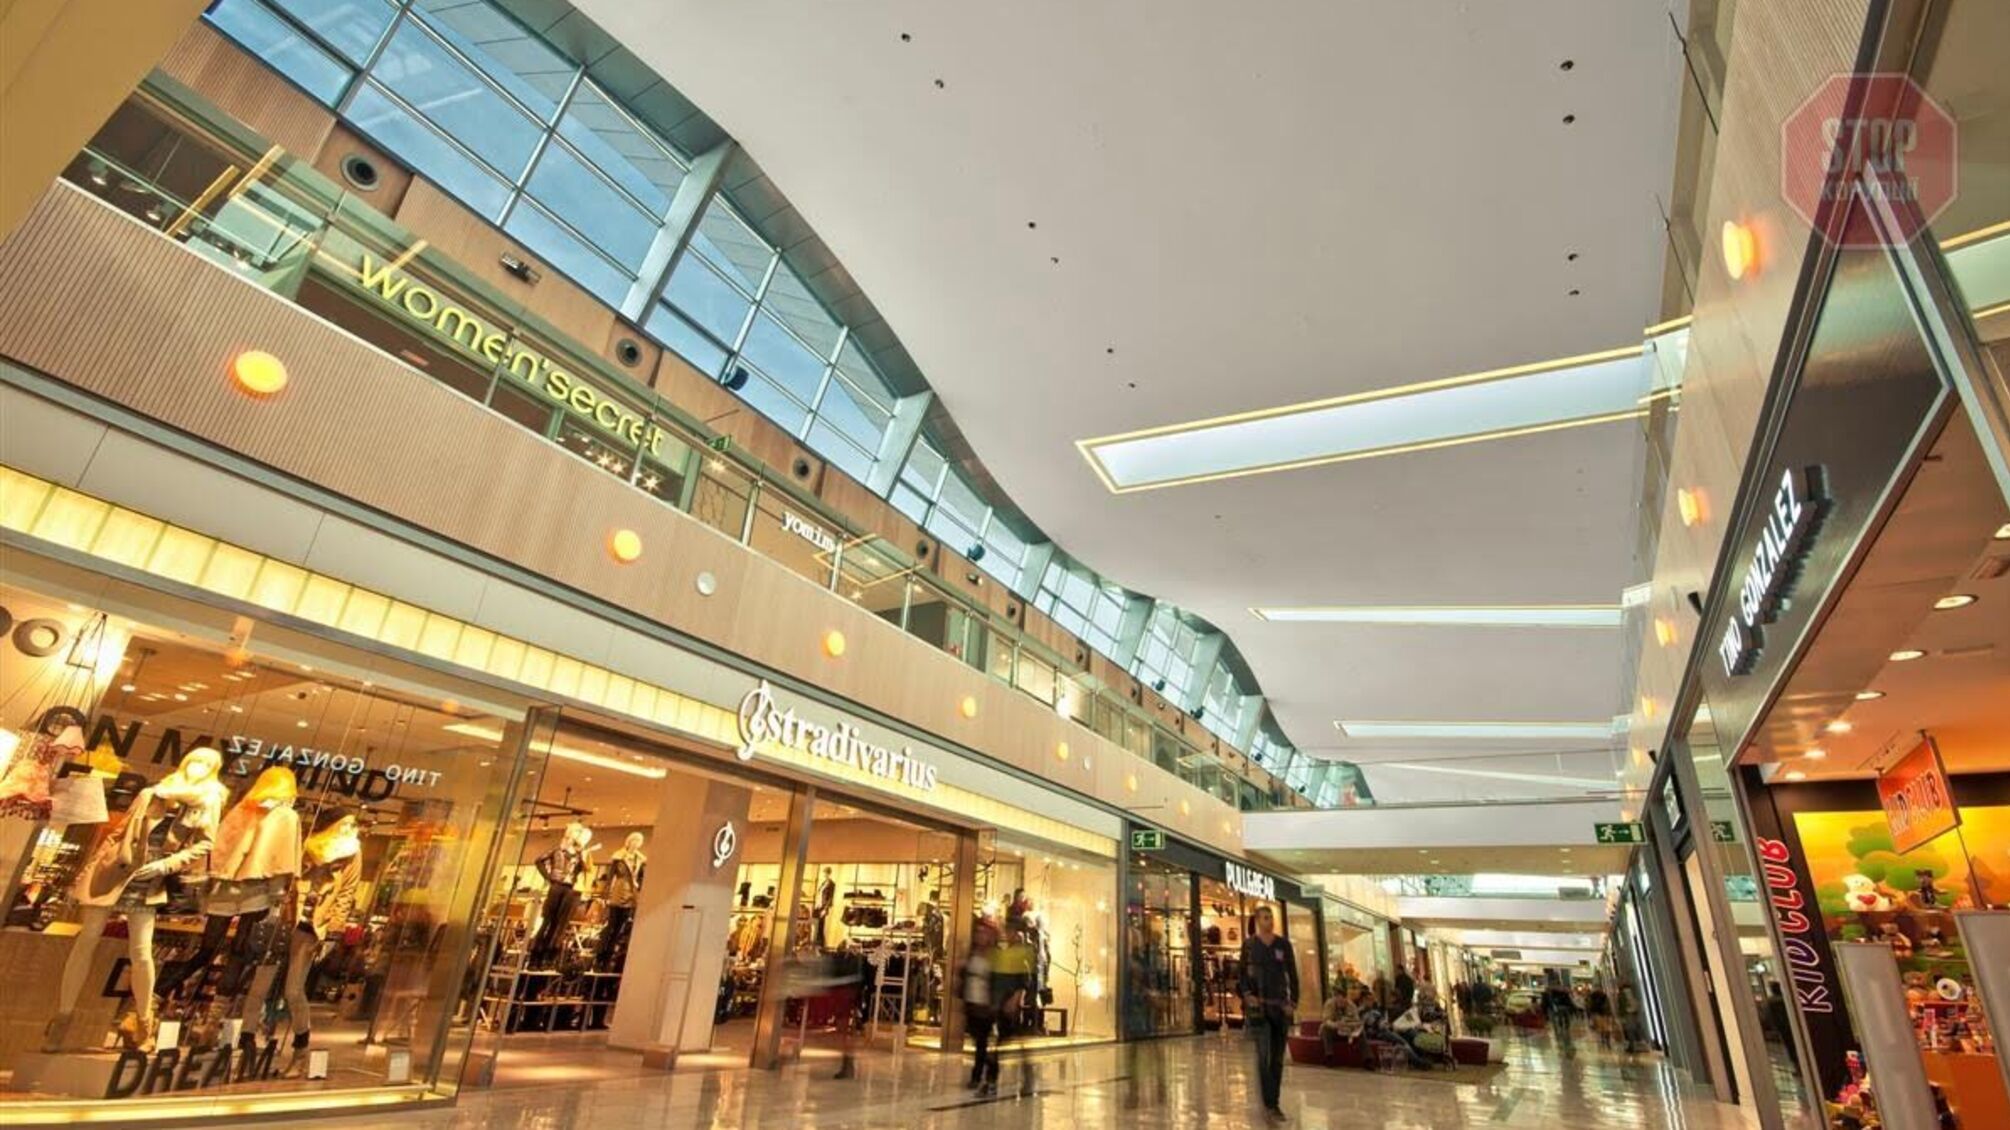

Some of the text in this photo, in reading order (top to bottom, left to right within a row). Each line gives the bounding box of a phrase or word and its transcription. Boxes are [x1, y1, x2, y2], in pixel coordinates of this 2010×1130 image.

[361, 253, 663, 456] women'secret
[1719, 468, 1802, 677] TINO GONZALEZ
[1225, 861, 1275, 902] PULL&BEAR
